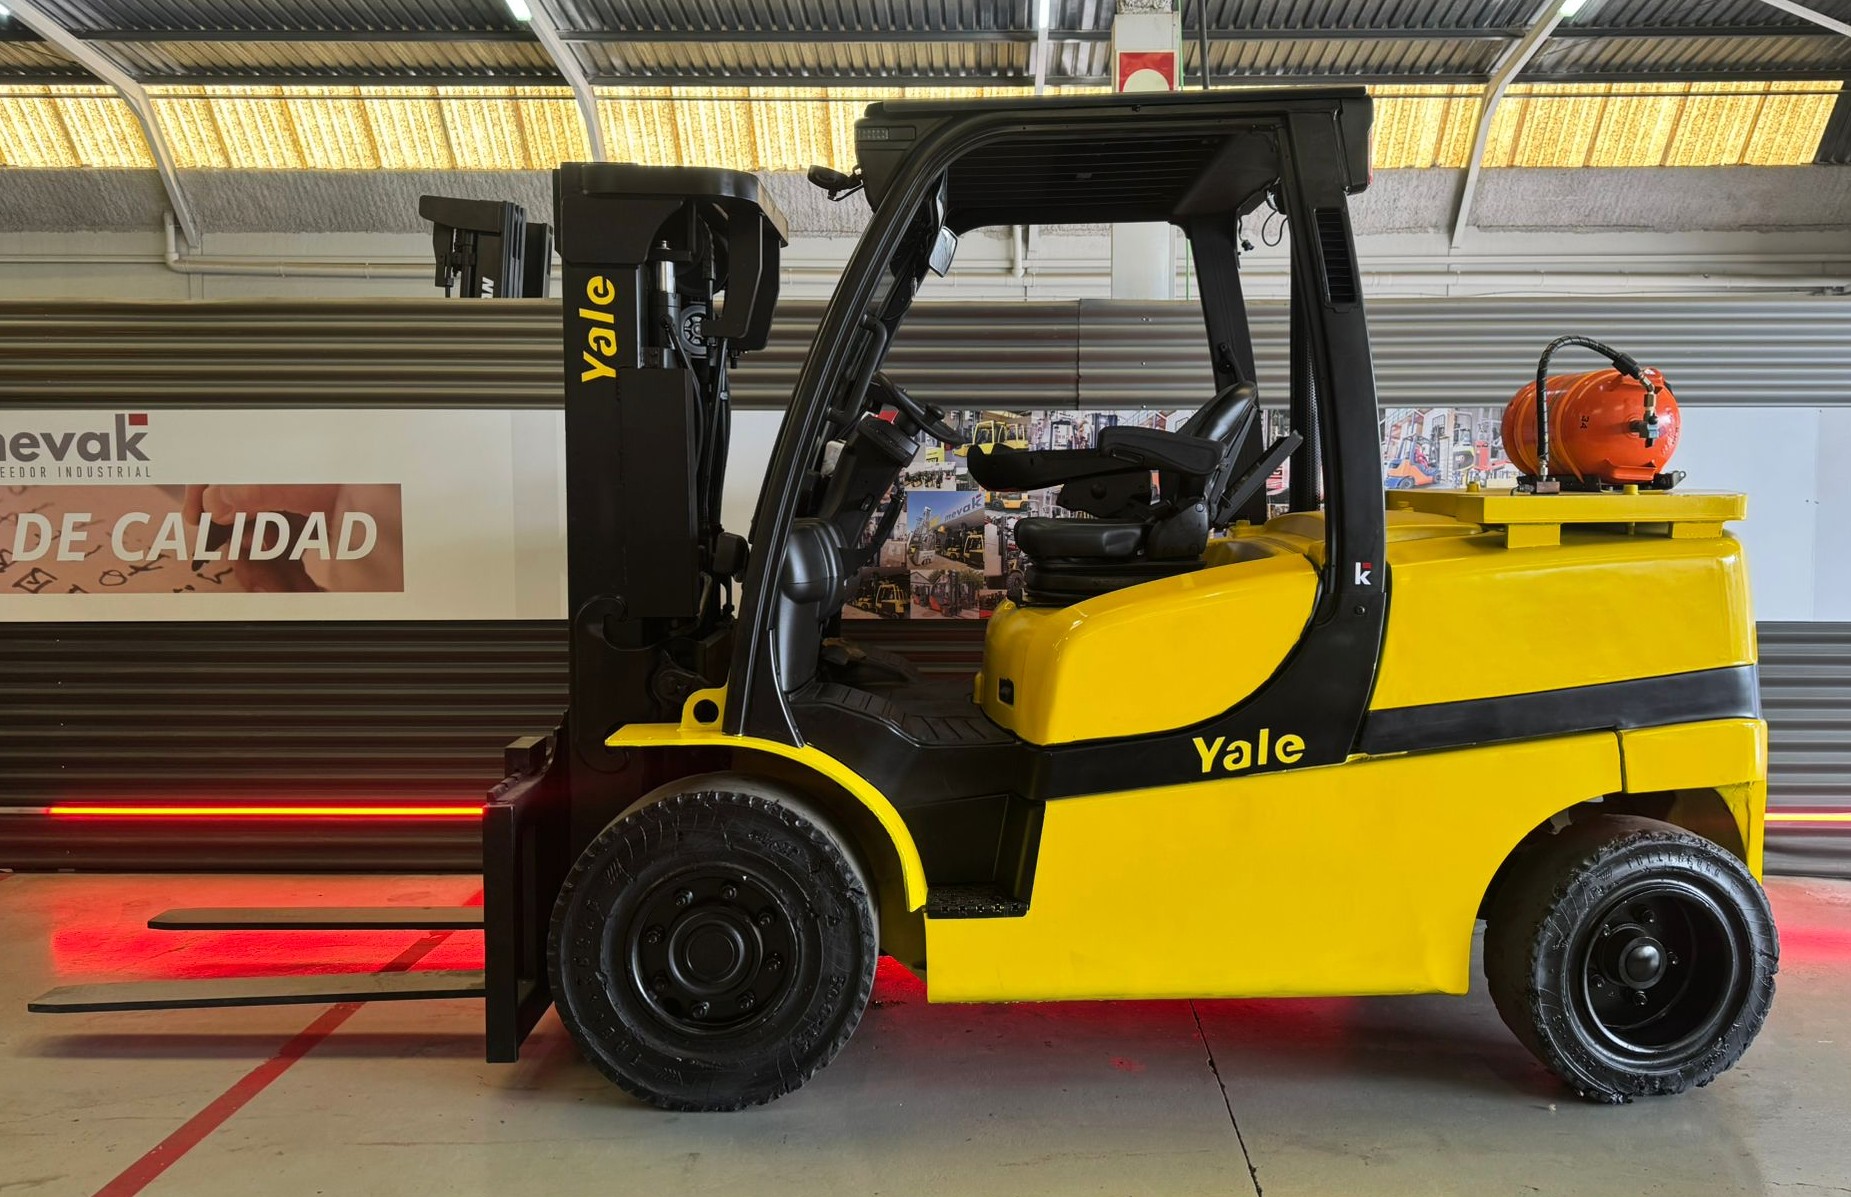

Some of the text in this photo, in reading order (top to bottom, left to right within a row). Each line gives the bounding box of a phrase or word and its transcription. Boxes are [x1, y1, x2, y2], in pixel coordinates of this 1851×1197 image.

[579, 275, 618, 383] Yale
[0, 413, 151, 463] evak
[58, 466, 151, 478] INDUSTRIAL
[11, 511, 378, 562] DE CALIDAD
[1192, 727, 1306, 773] Yale
